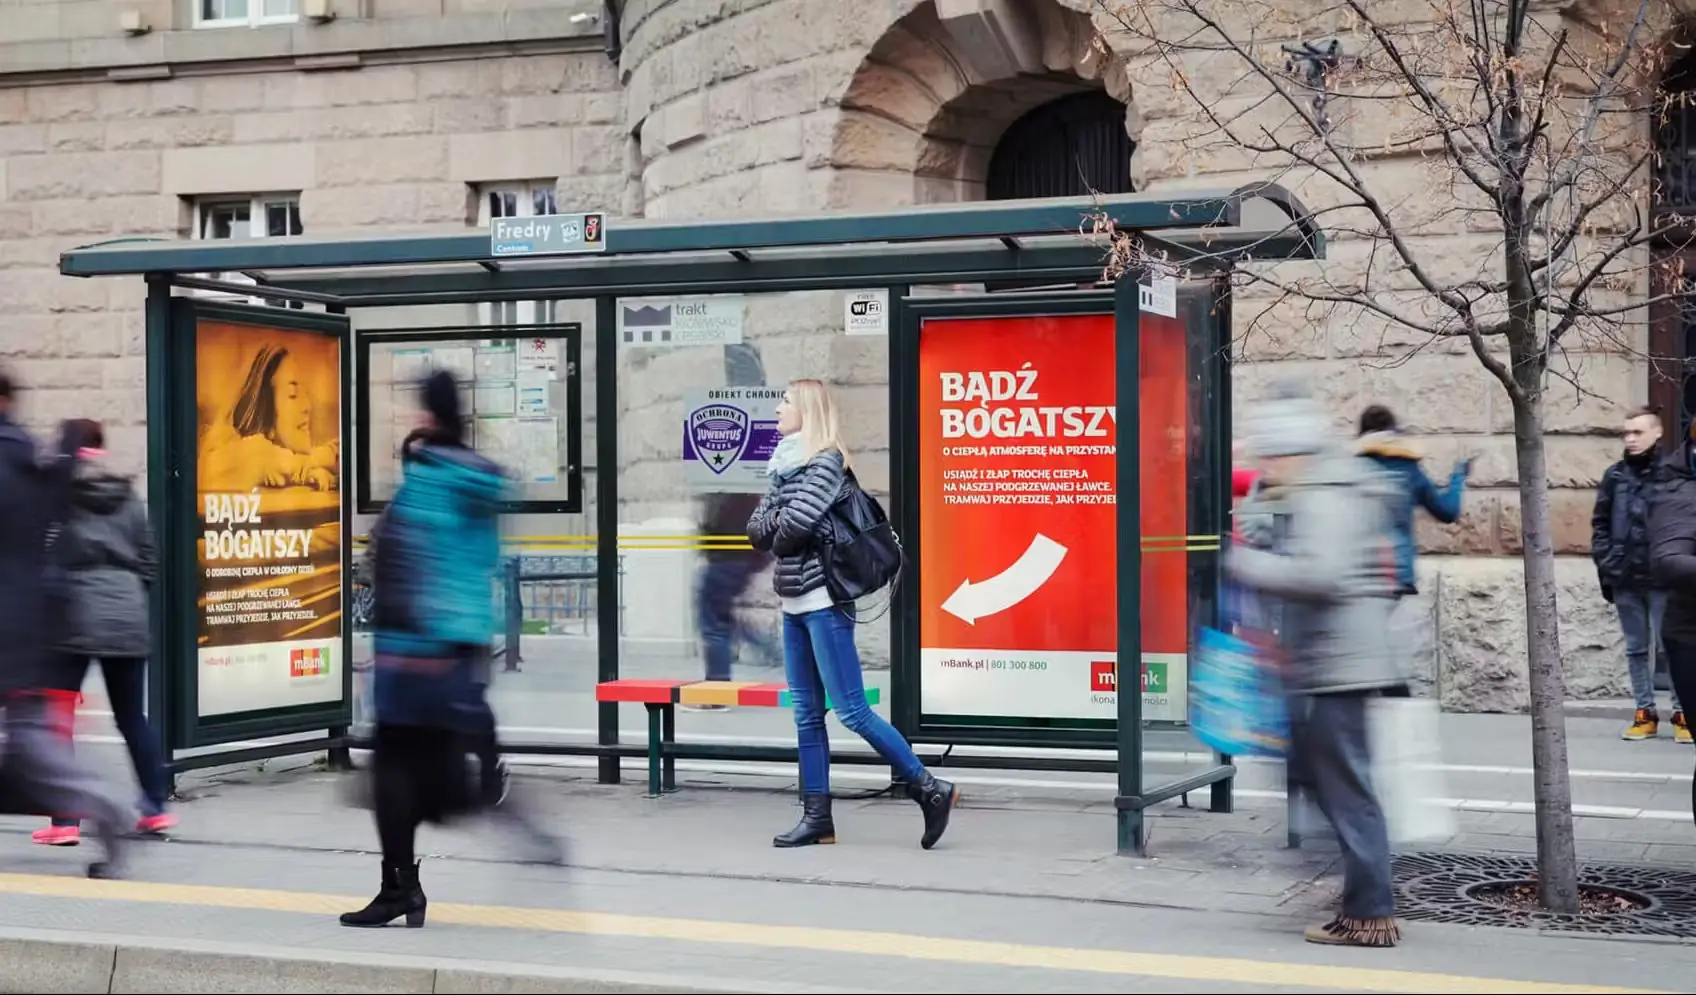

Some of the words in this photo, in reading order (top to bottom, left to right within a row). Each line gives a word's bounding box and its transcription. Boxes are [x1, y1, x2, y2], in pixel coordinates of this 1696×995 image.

[497, 221, 551, 242] Fredry
[676, 303, 707, 316] trakt
[940, 362, 1038, 409] BĄDŹ
[708, 390, 741, 399] OBIEKT
[696, 408, 742, 422] OCHRONA
[696, 427, 742, 441] JUWENTUS
[943, 446, 950, 456] O
[952, 446, 988, 458] CIEPŁĄ
[989, 446, 1047, 457] ATMOSFERĘ
[1049, 445, 1064, 455] NA
[943, 468, 978, 481] USIĄDŹ
[980, 470, 985, 479] I
[986, 469, 1010, 479] ZŁAP
[1012, 469, 1051, 481] TROCHĘ
[1052, 469, 1088, 479] CIEPŁA
[943, 482, 957, 492] NA
[959, 482, 994, 492] NASZEJ
[995, 481, 1074, 492] PODGRZEWANEJ
[1076, 481, 1112, 492] ŁAWCE.
[943, 494, 991, 505] TRAMWAJ
[992, 494, 1054, 506] PRZYJEDZIE,
[1055, 494, 1074, 504] JAK
[204, 488, 261, 531] BĄDŹ
[204, 528, 312, 560] BOGATSZY
[940, 658, 984, 671] mBank.pl
[991, 660, 1006, 669] 801
[1010, 660, 1027, 670] 300
[1028, 661, 1047, 670] 800
